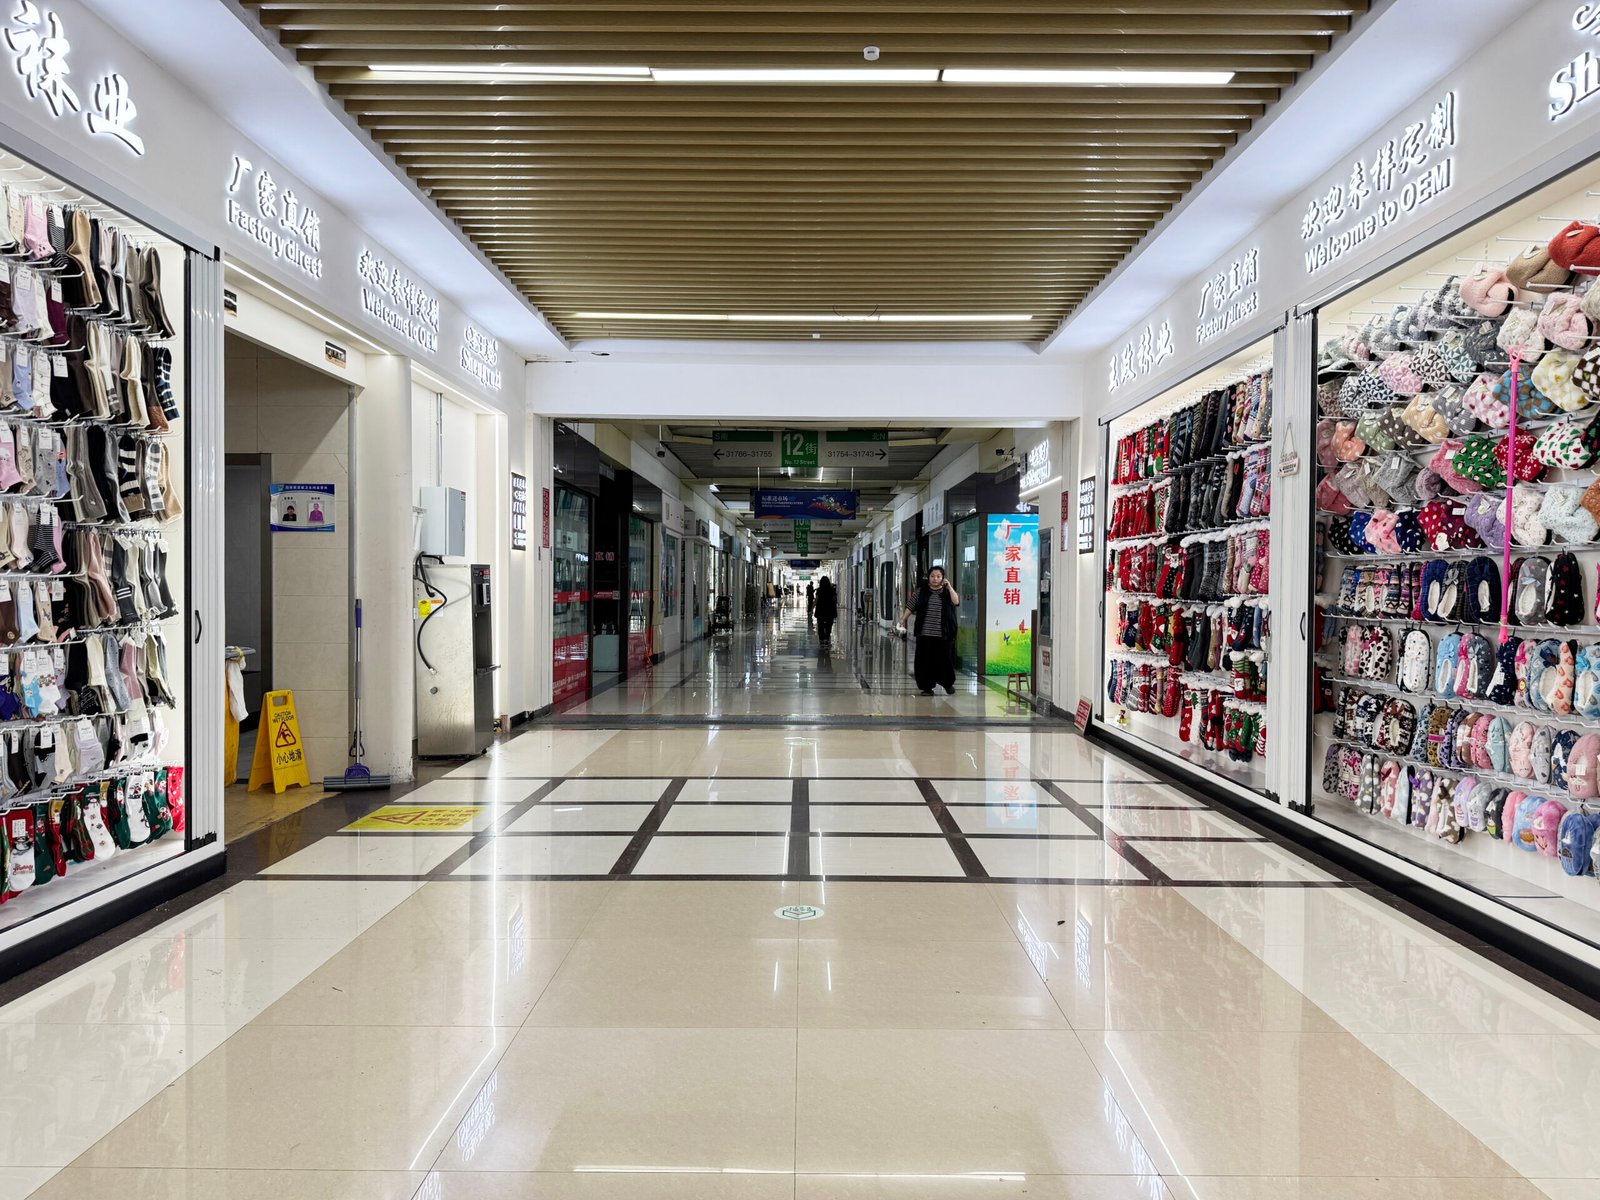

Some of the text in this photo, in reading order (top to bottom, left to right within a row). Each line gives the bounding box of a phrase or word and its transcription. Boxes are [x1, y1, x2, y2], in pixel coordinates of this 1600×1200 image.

[229, 156, 321, 252] 厂家直销
[1301, 91, 1455, 239] 欢迎来样定制
[1305, 159, 1452, 273] Welcome to OEM
[360, 250, 439, 333] 欢迎来样定制
[363, 288, 408, 333] Welcome
[418, 324, 438, 353] OEM
[1199, 248, 1258, 318] 厂家直销
[1004, 524, 1022, 606] 厂家直销
[276, 749, 302, 765] 小心地滑
